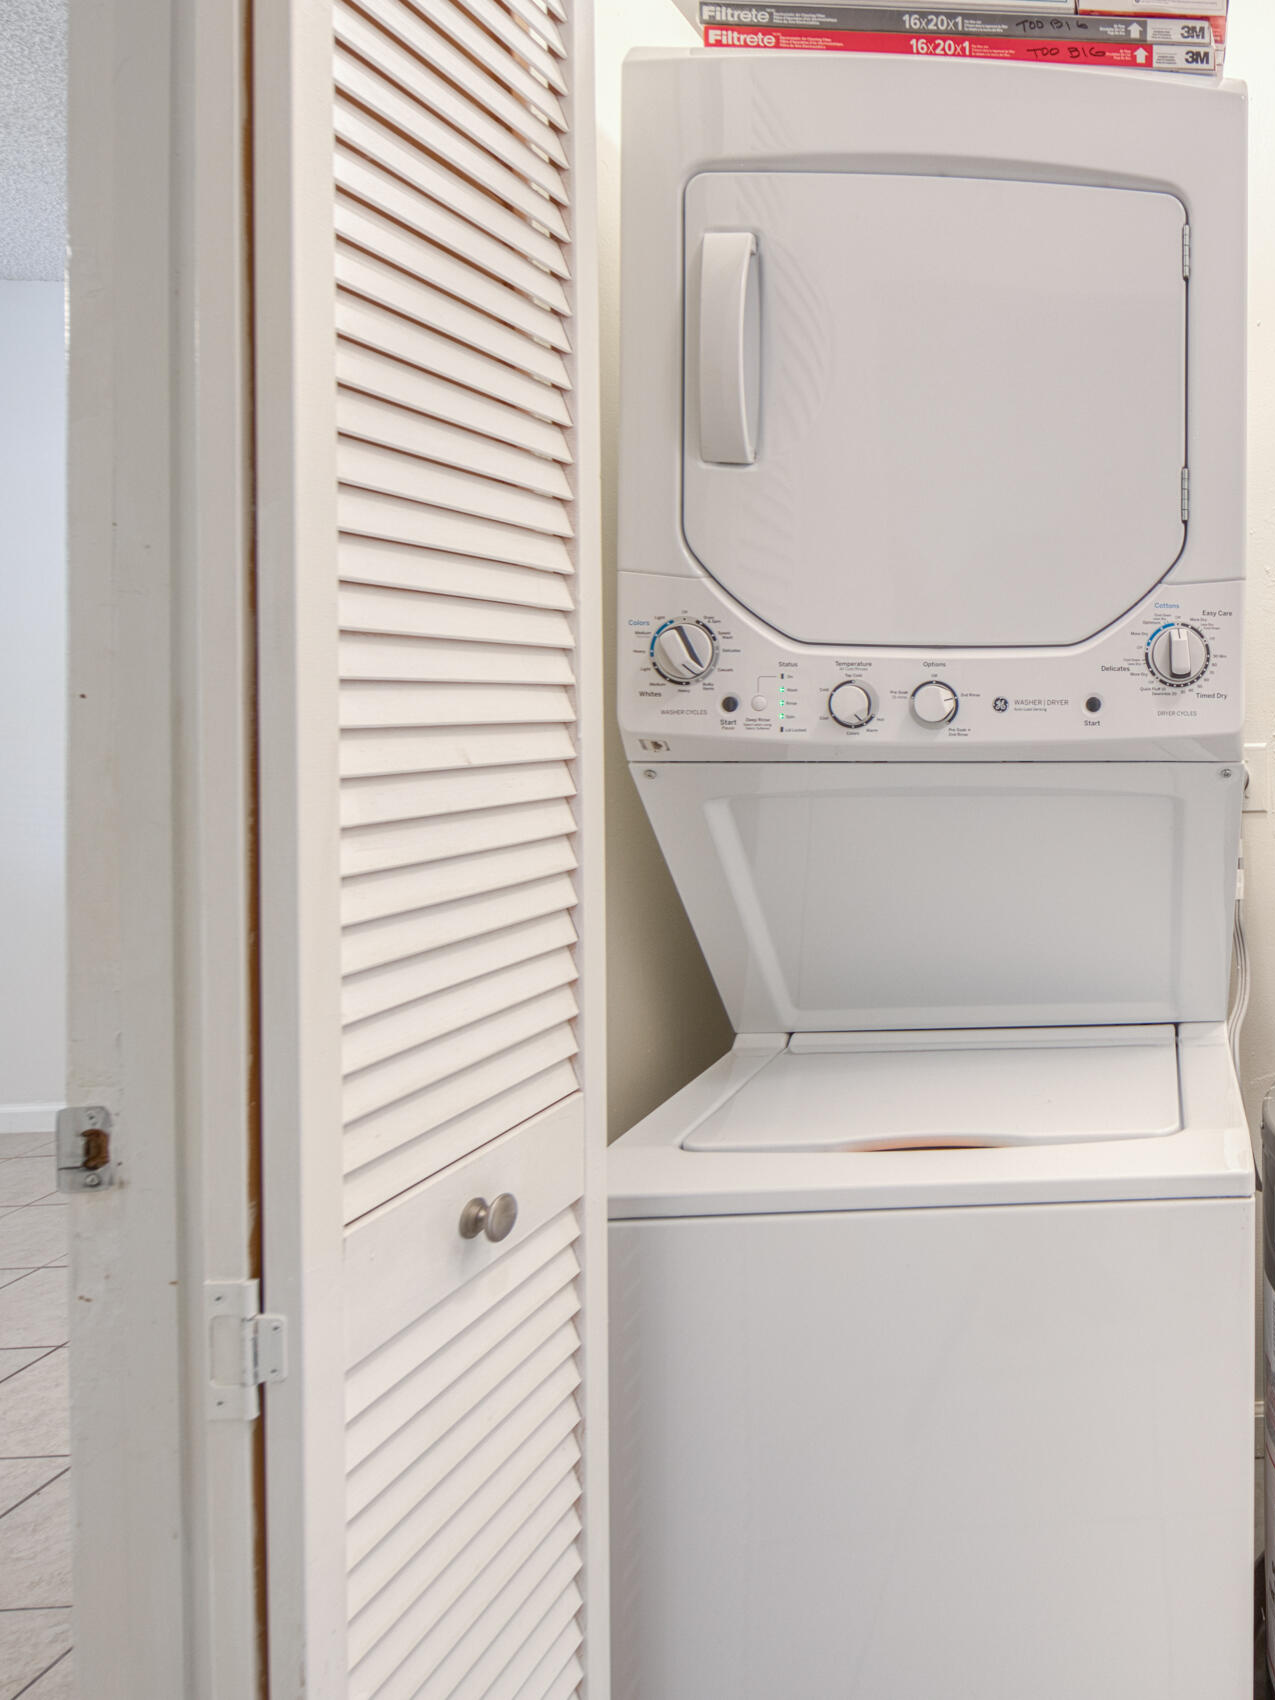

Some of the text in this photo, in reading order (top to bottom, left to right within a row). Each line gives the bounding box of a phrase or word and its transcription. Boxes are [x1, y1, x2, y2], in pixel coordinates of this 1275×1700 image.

[702, 5, 770, 23] Filtrete
[902, 14, 962, 31] 16x20x1
[1016, 19, 1044, 32] TOO
[708, 29, 776, 47] Filtrete
[1180, 25, 1206, 40] 3M
[910, 38, 970, 56] 16x20x1
[1026, 47, 1060, 59] TOO
[1068, 47, 1107, 59] BIG
[1184, 50, 1210, 65] 3M
[628, 619, 650, 627] Colors
[835, 661, 873, 669] Temperature
[922, 661, 946, 669] Options
[1216, 692, 1228, 700] Dry
